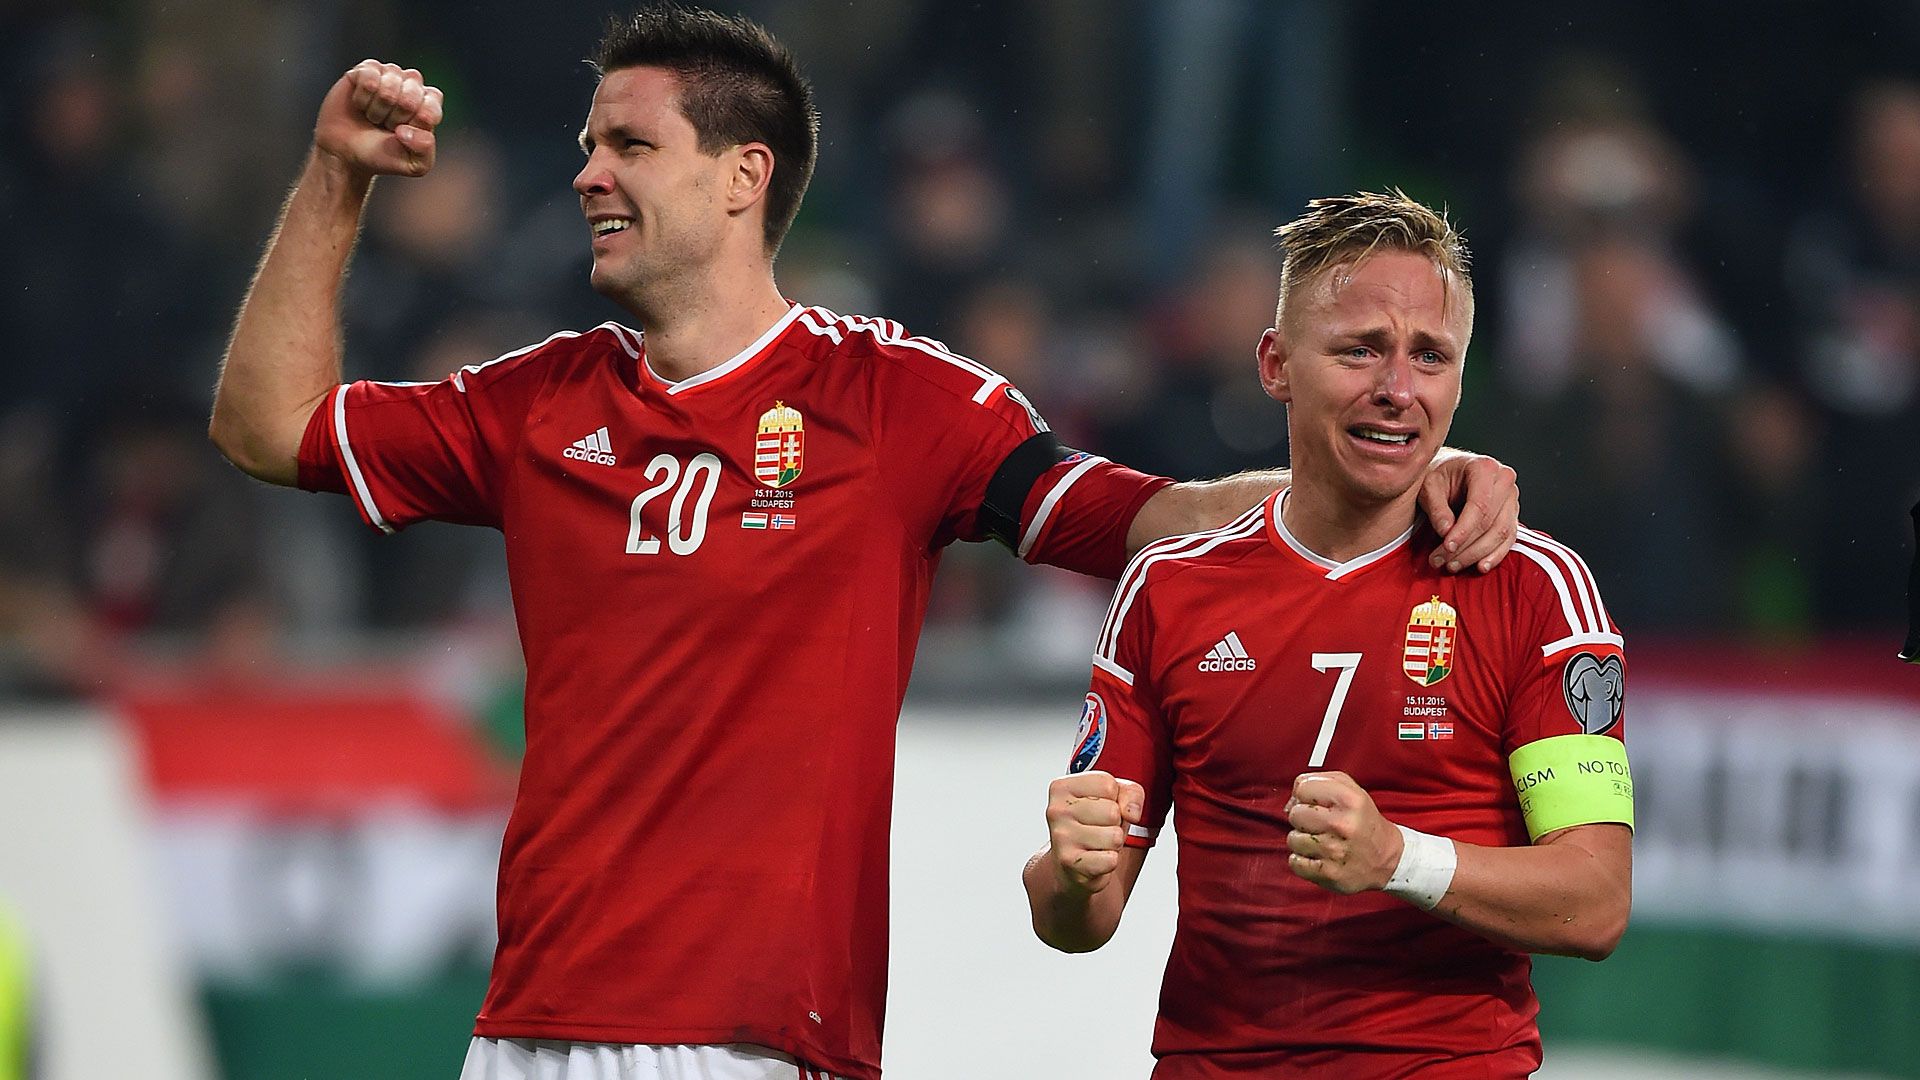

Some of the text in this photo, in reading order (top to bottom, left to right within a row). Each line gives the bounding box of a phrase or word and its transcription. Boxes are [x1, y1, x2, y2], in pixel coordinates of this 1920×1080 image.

[563, 446, 617, 467] adidas
[754, 489, 794, 498] 15.11.2015
[625, 453, 722, 556] 20
[751, 499, 795, 508] BUDAPEST
[1198, 656, 1256, 672] adidas
[1406, 696, 1446, 706] 15.11.2015
[1307, 652, 1363, 768] 7
[1403, 706, 1448, 716] BUDAPEST
[1577, 760, 1604, 774] NO
[1605, 761, 1624, 776] TO
[1516, 768, 1555, 793] CISM
